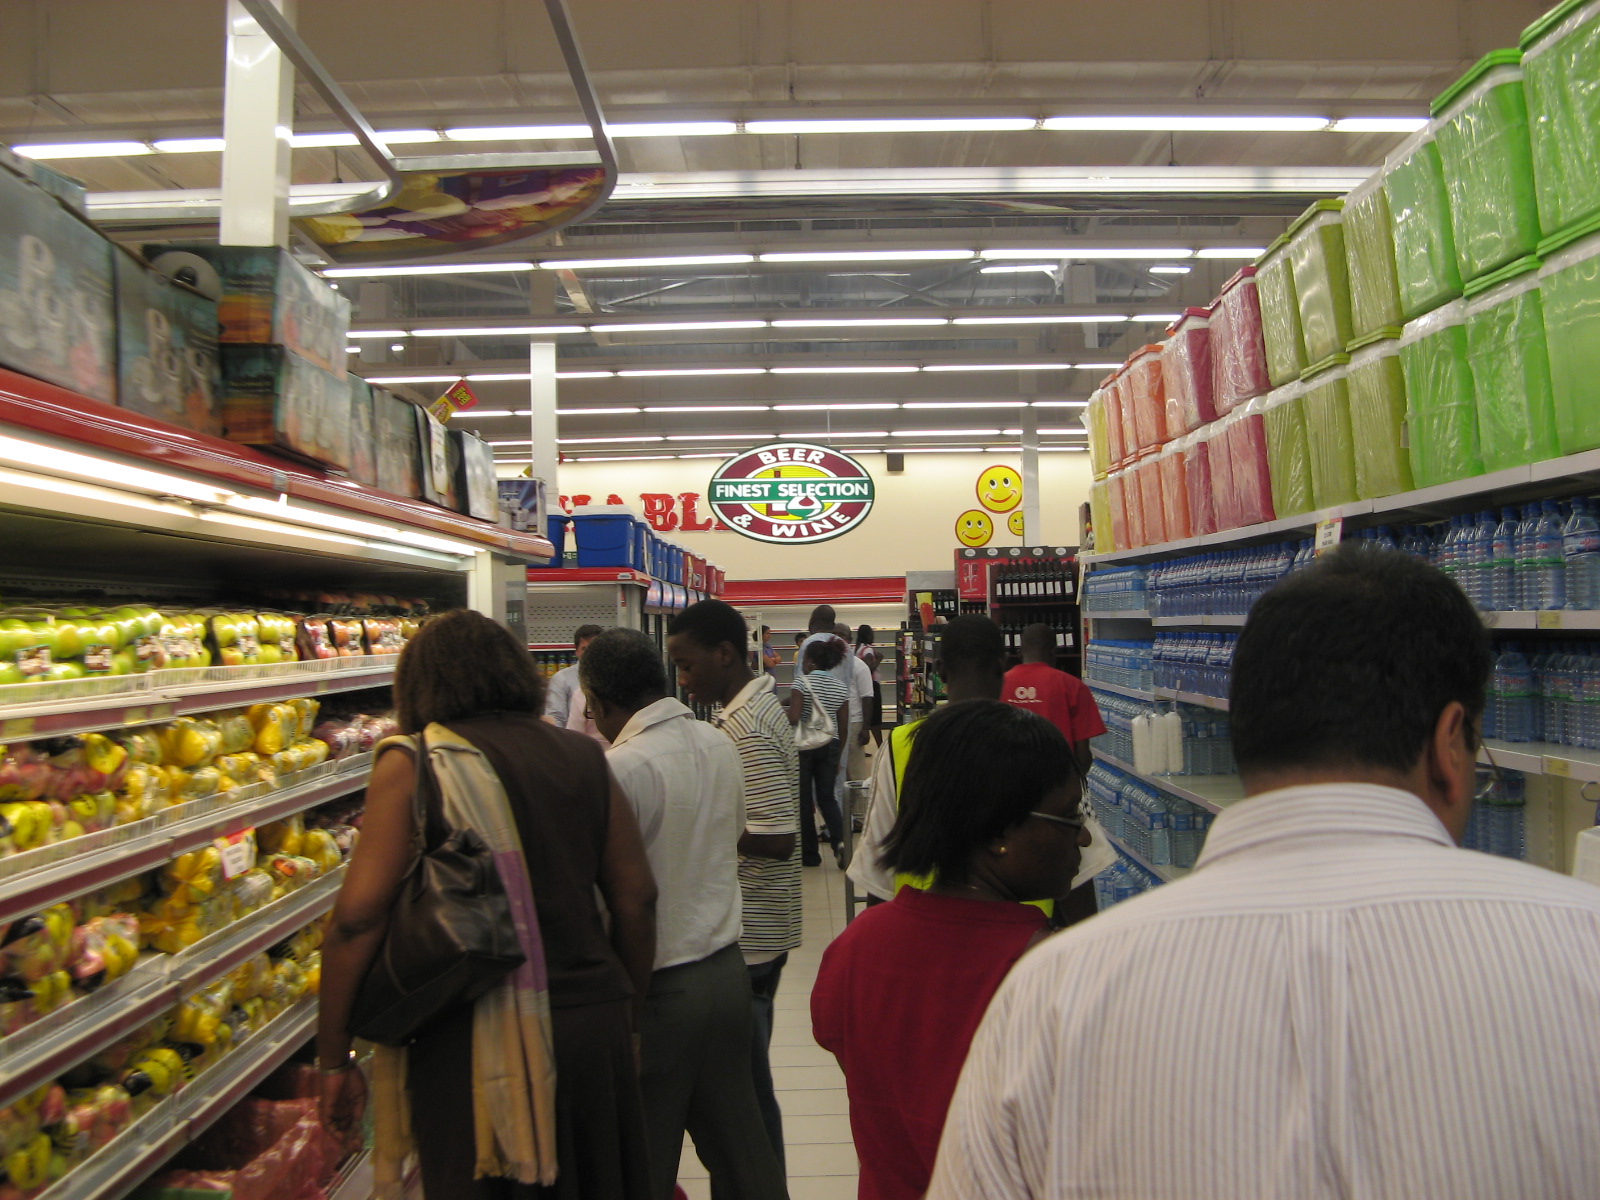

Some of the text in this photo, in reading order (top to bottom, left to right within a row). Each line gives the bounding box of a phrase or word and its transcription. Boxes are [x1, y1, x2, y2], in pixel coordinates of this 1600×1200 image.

[757, 448, 825, 465] BEER
[716, 482, 869, 498] FINEST SELECTION
[732, 511, 851, 537] & WINE
